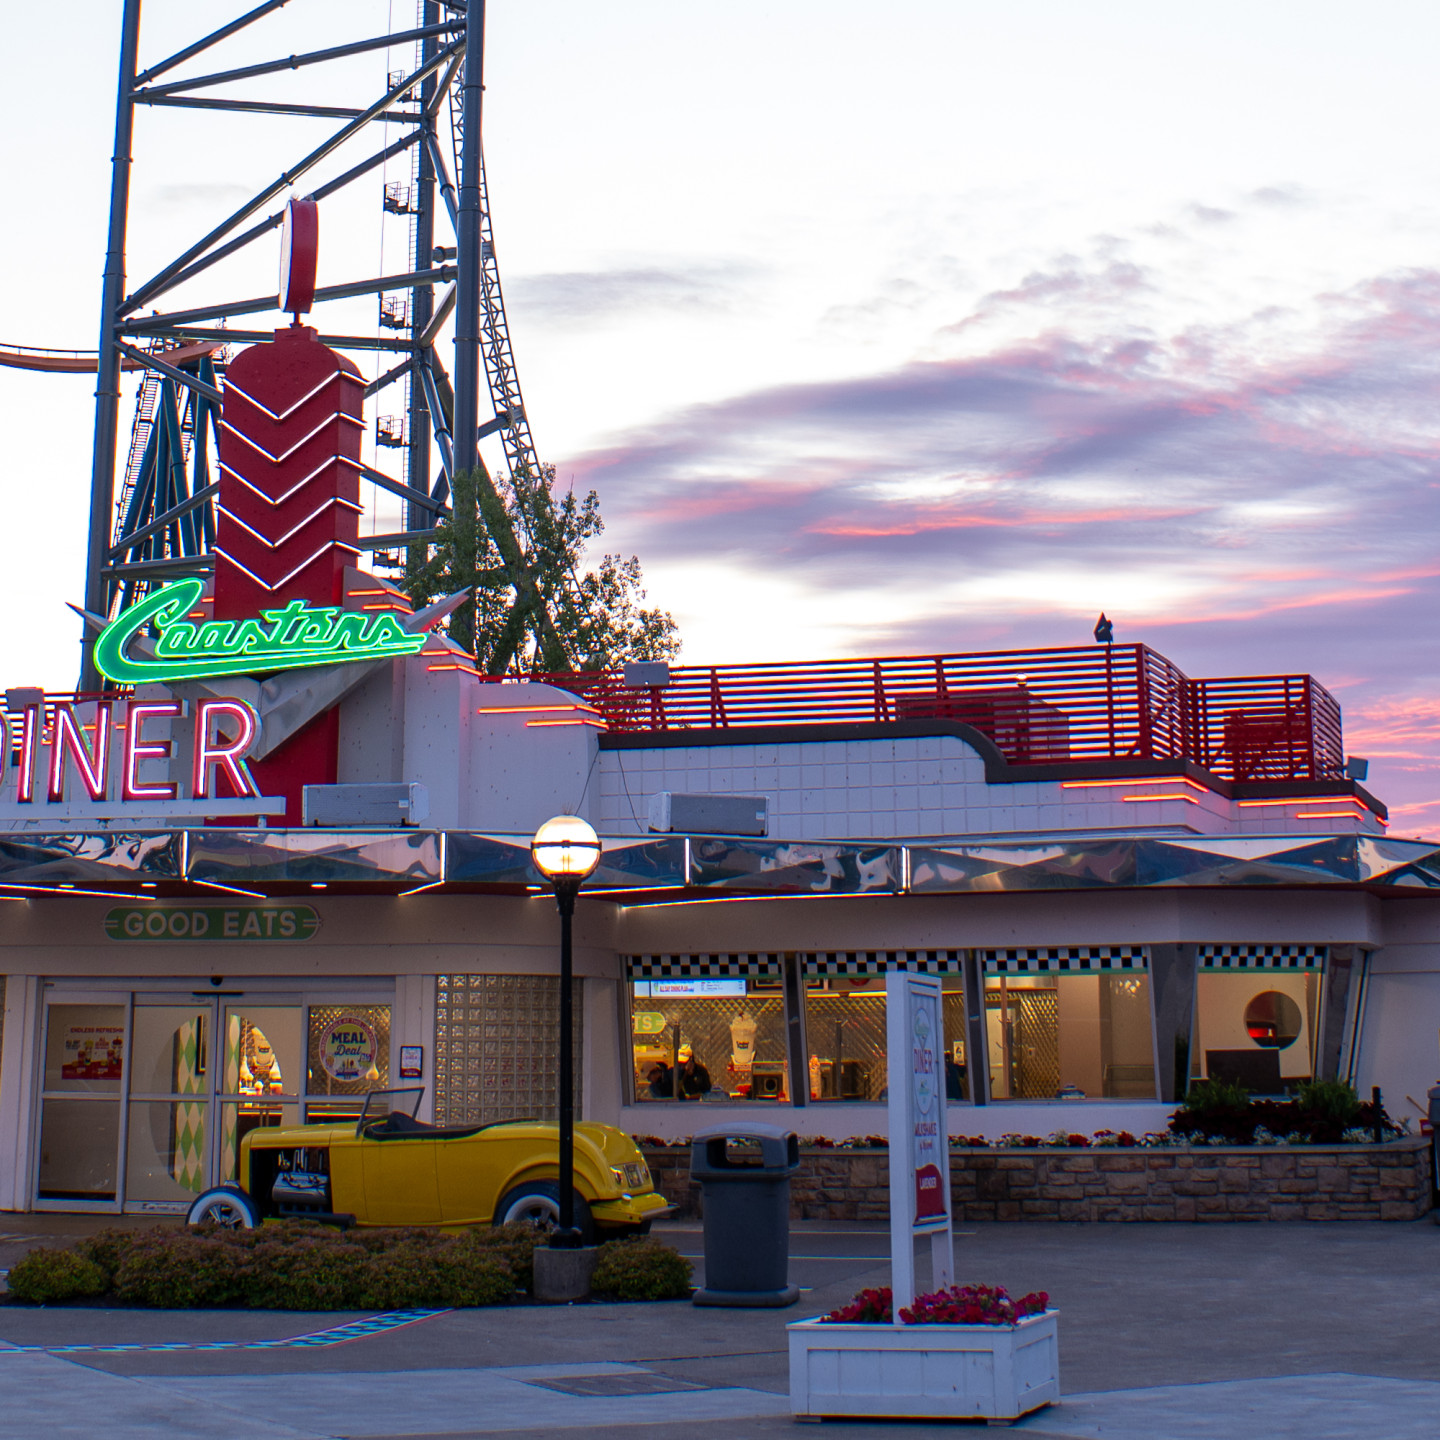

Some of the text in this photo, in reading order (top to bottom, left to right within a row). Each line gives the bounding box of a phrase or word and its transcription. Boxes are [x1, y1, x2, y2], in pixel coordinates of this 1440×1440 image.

[94, 577, 429, 684] Coasters
[124, 911, 297, 937] GOOD EATS
[331, 1032, 366, 1044] MEAL
[334, 1044, 362, 1056] Deal
[914, 1049, 933, 1074] DINER
